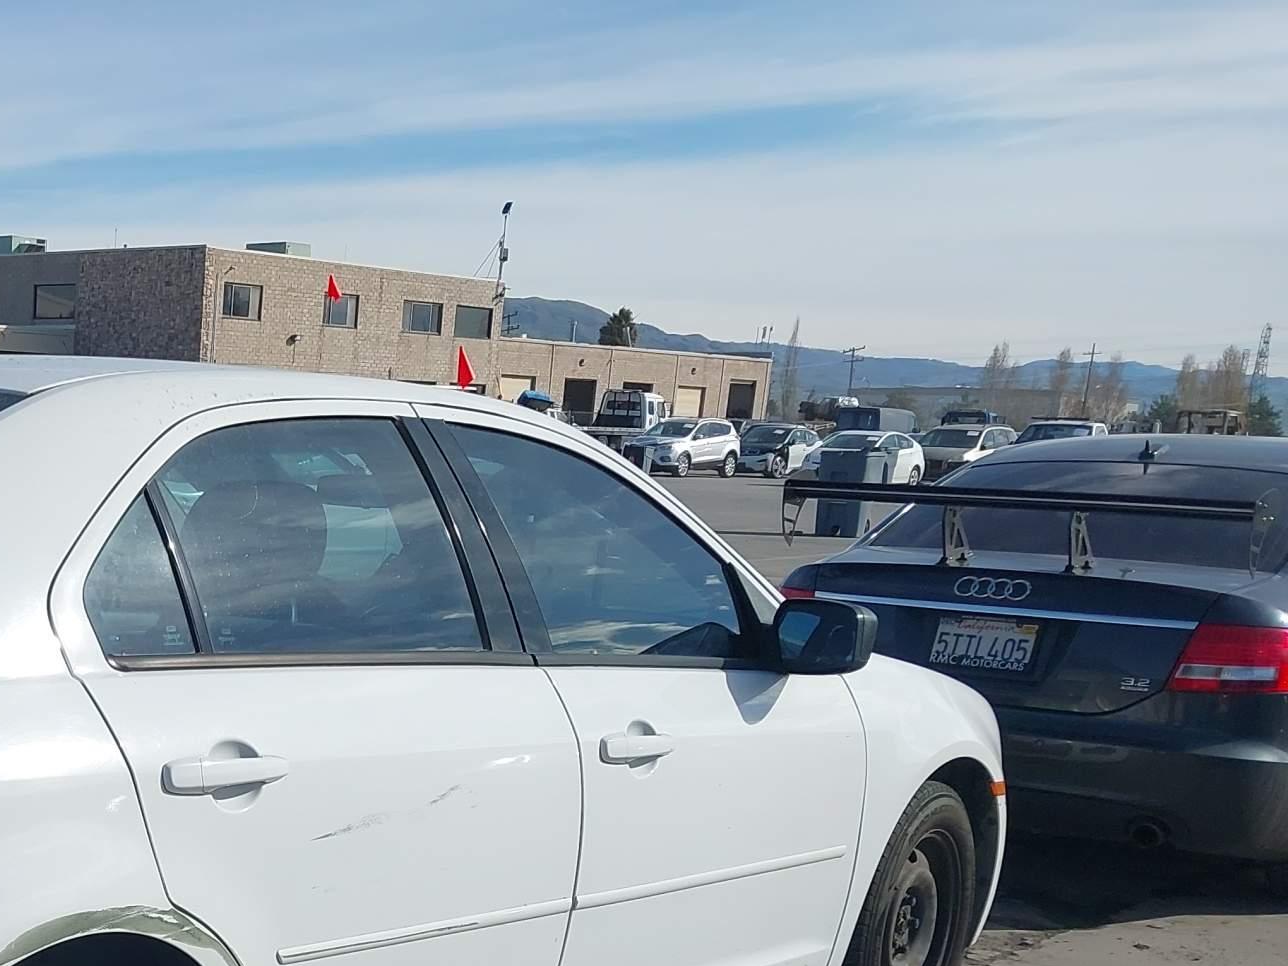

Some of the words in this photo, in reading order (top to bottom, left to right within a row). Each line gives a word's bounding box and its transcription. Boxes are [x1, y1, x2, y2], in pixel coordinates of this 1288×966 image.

[955, 620, 1016, 634] California
[934, 631, 1030, 662] 5TTL405
[929, 653, 959, 665] RMC
[960, 657, 1025, 671] MOTORCARS
[1120, 677, 1150, 687] 3.2
